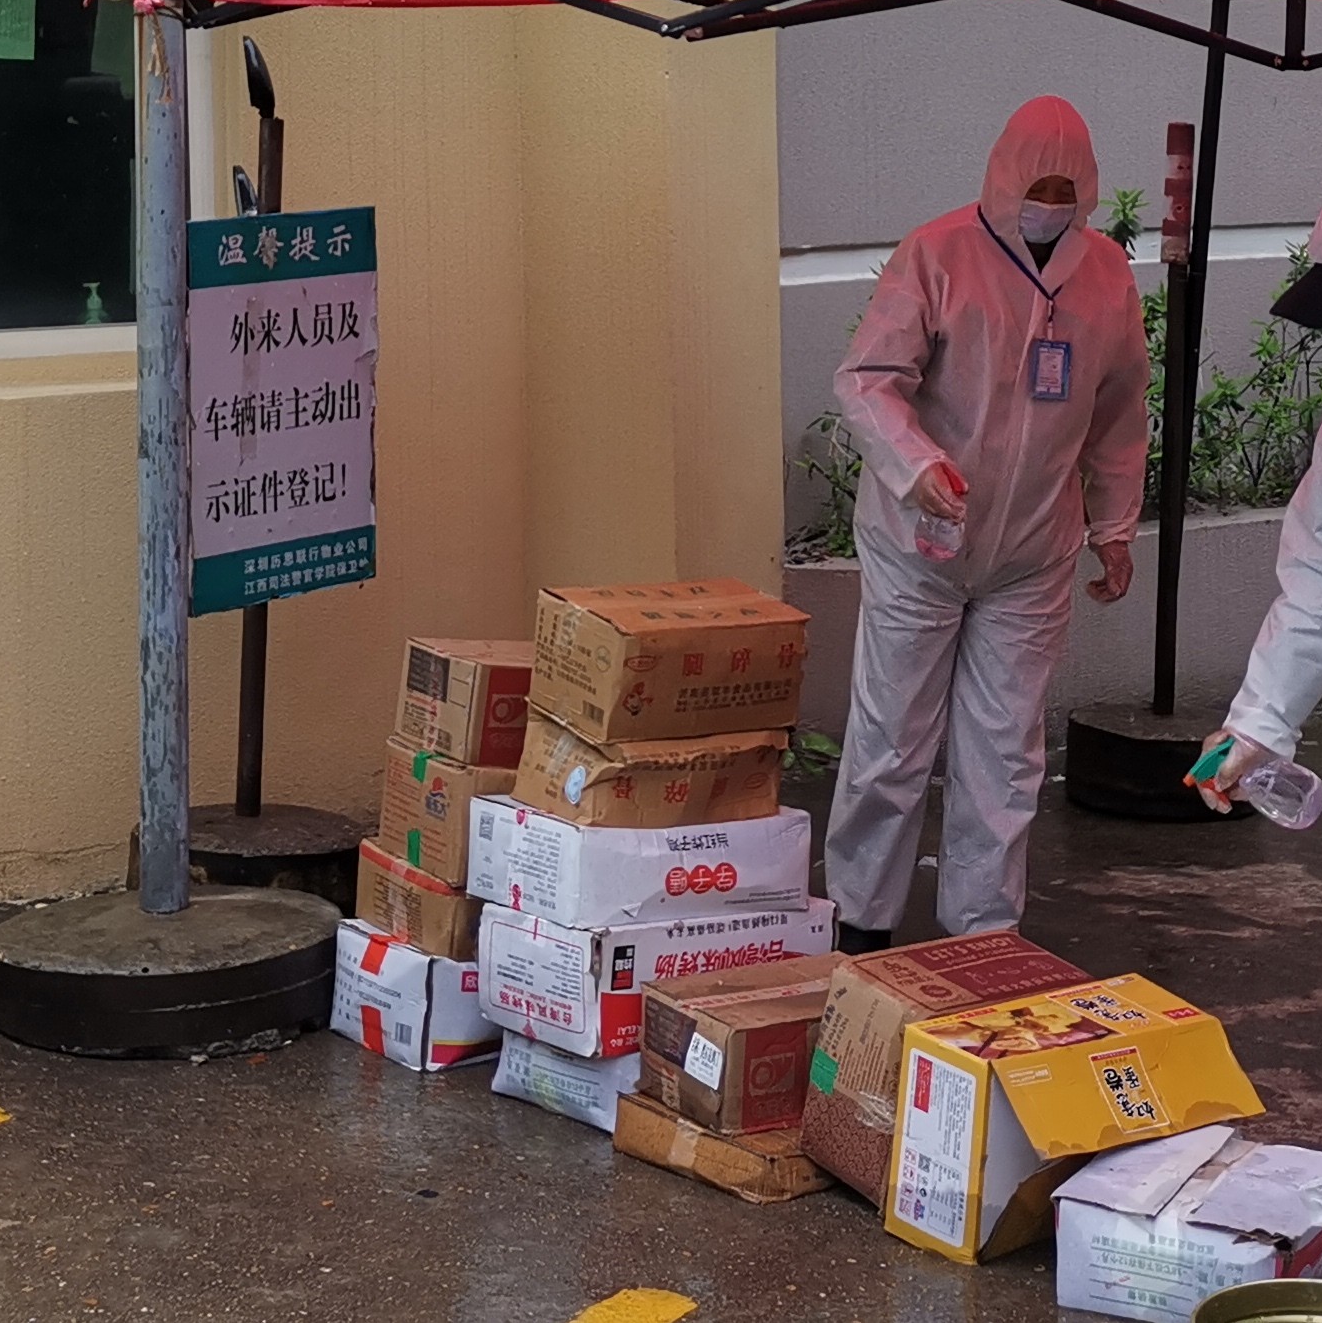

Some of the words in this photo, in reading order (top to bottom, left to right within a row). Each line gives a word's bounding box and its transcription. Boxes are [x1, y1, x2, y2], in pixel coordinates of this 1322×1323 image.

[217, 224, 353, 269] 温馨提示
[229, 299, 360, 356] 外来人员及
[203, 379, 362, 443] 车辆请主动出
